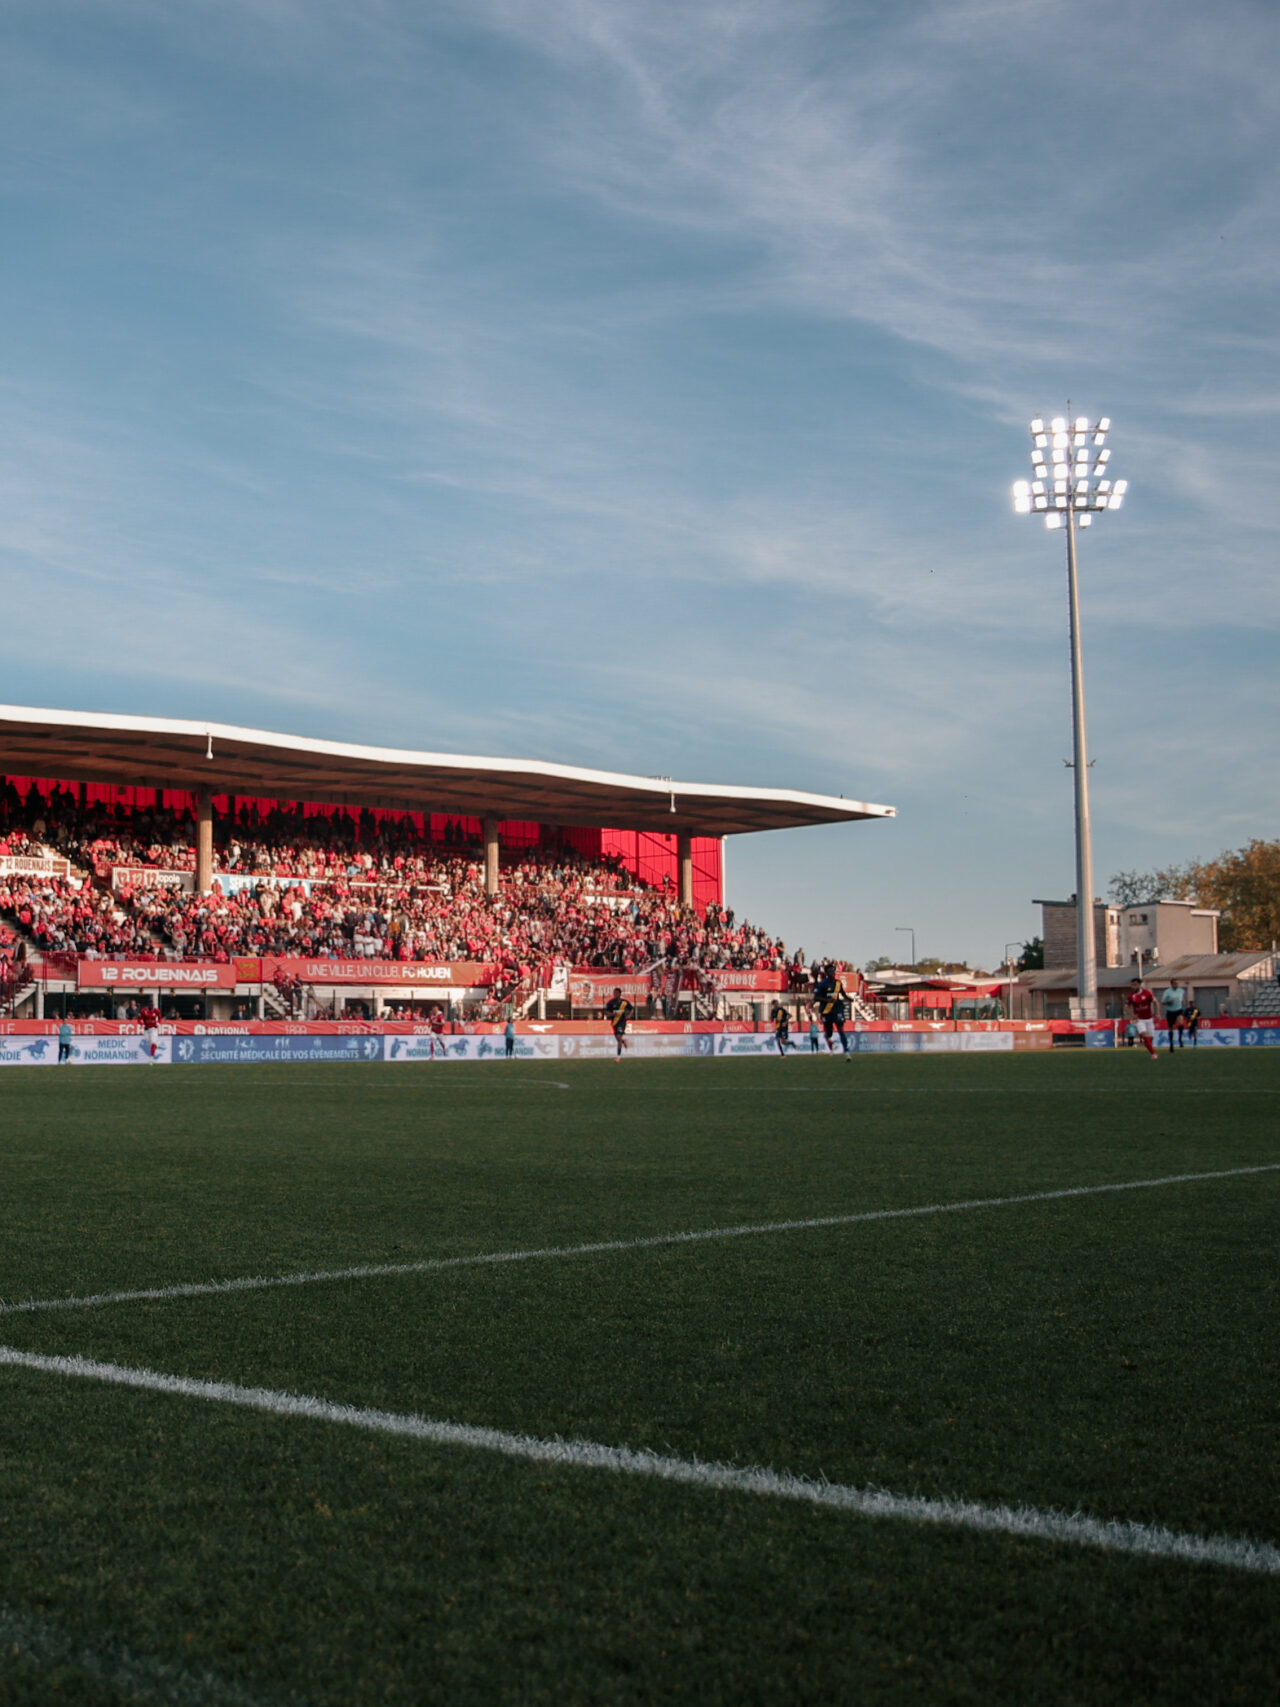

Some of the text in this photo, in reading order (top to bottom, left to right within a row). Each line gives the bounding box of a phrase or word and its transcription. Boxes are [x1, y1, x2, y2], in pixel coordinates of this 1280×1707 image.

[5, 858, 14, 870] 12
[101, 967, 218, 982] 12 ROUENNAIS
[306, 963, 328, 976] UNE
[402, 967, 415, 978] FC
[417, 967, 452, 980] ROUEN
[207, 1026, 251, 1036] NATIONAL
[97, 1039, 126, 1049] MEDIC
[84, 1050, 139, 1060] NORMANDIE
[200, 1048, 360, 1060] SÉCURITÉ MÉDICALE DE VOS ÉVÉNEMENTS
